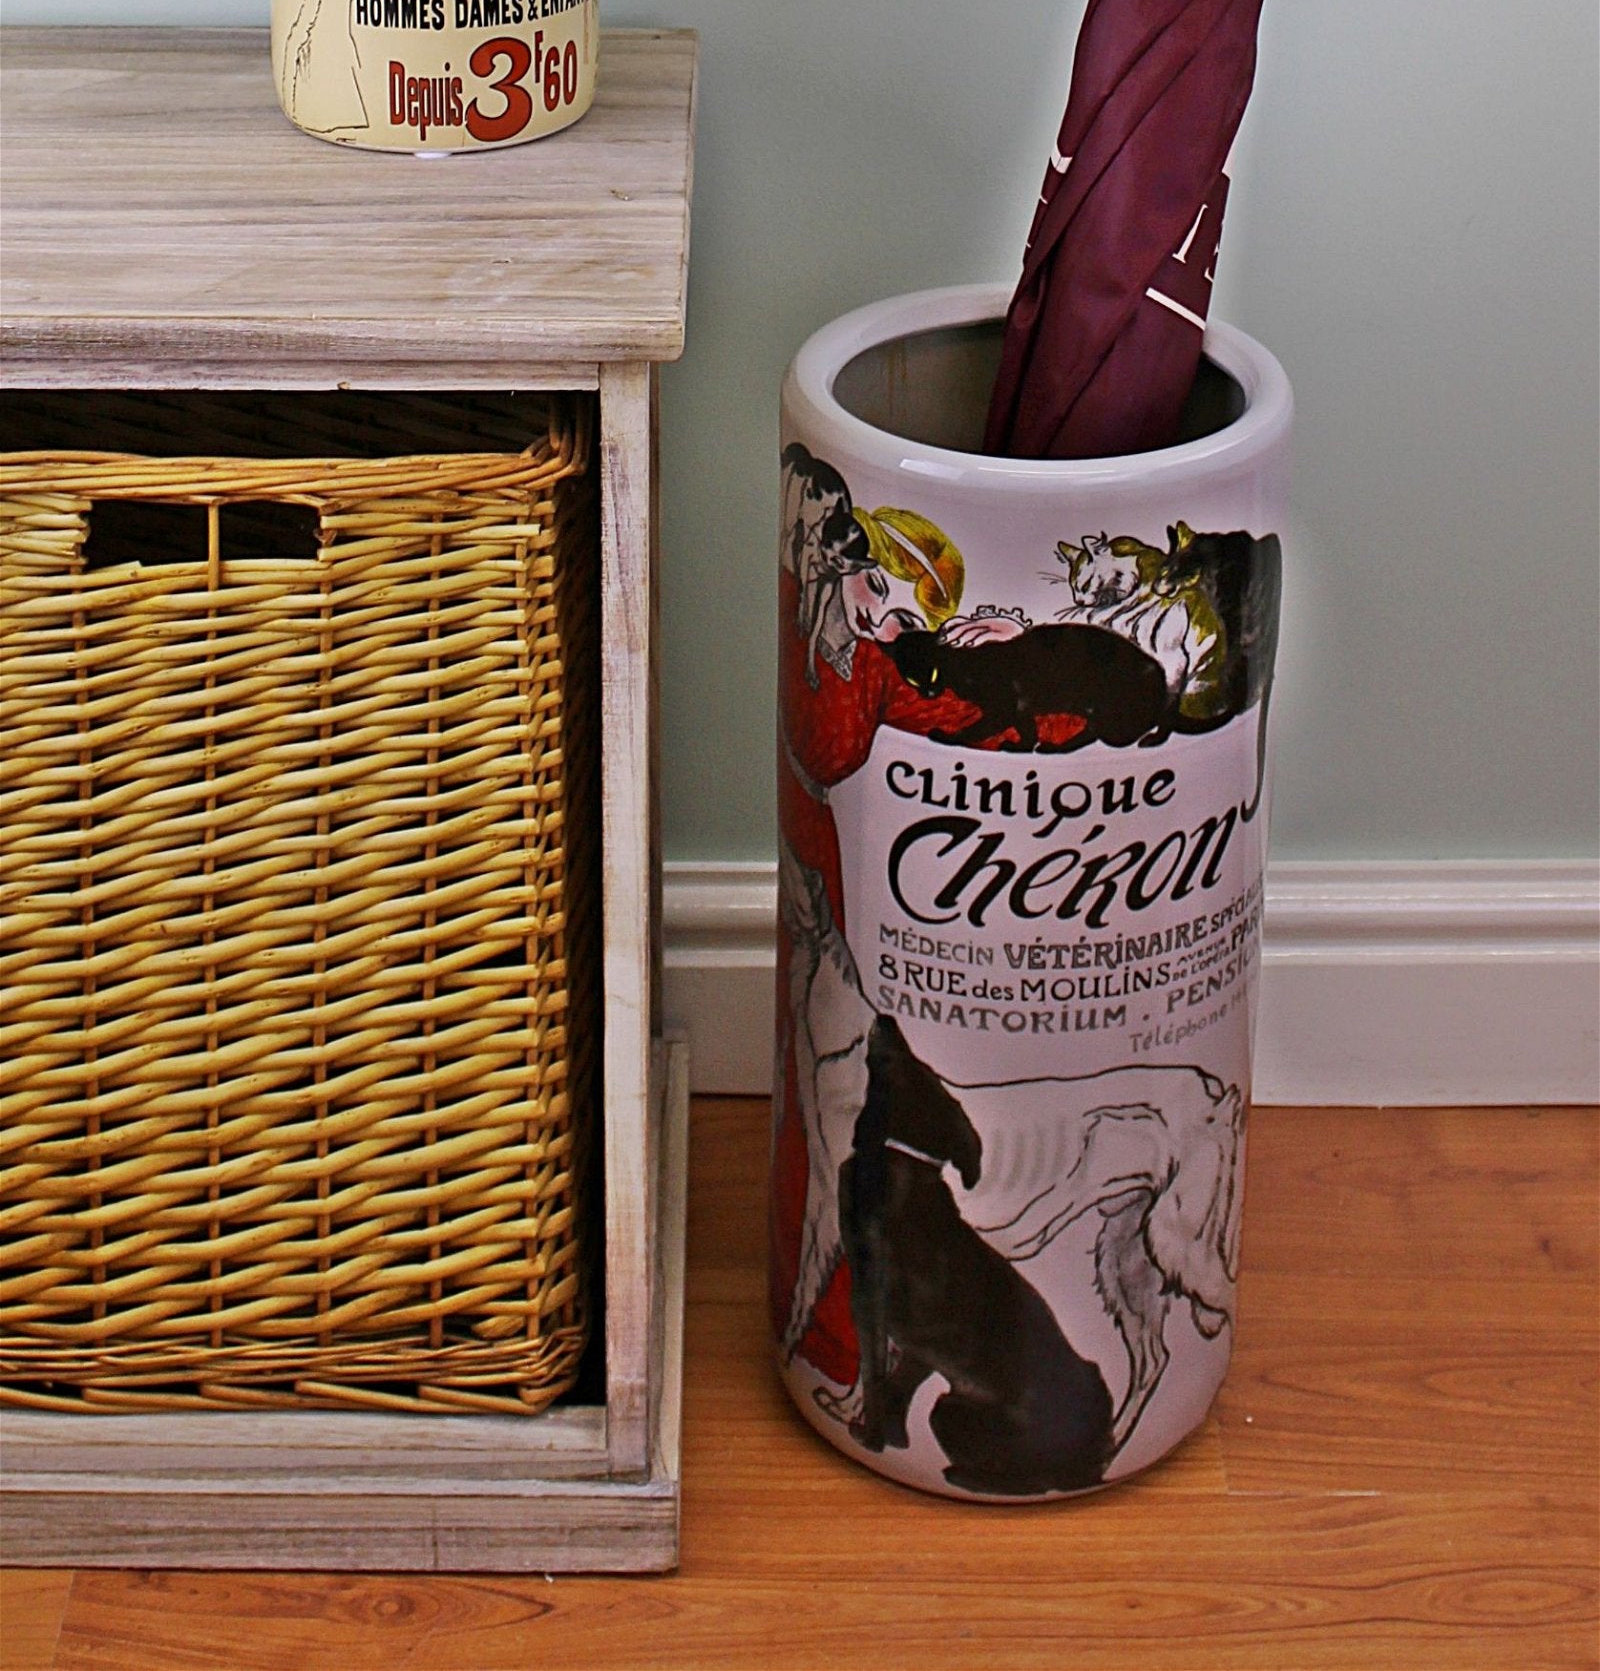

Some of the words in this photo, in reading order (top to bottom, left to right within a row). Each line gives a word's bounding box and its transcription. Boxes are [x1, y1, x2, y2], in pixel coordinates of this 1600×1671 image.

[388, 60, 463, 142] Depuis
[879, 922, 994, 967] MÉDECIN
[1003, 915, 1208, 971] VÉTÉRINAIRE
[878, 953, 899, 981] 8
[903, 960, 967, 998] RUE
[972, 979, 1014, 1001] des
[1021, 960, 1171, 1003] MOULINS
[876, 984, 1127, 1034] SANATORIUM
[1129, 1004, 1228, 1054] Téléphone
